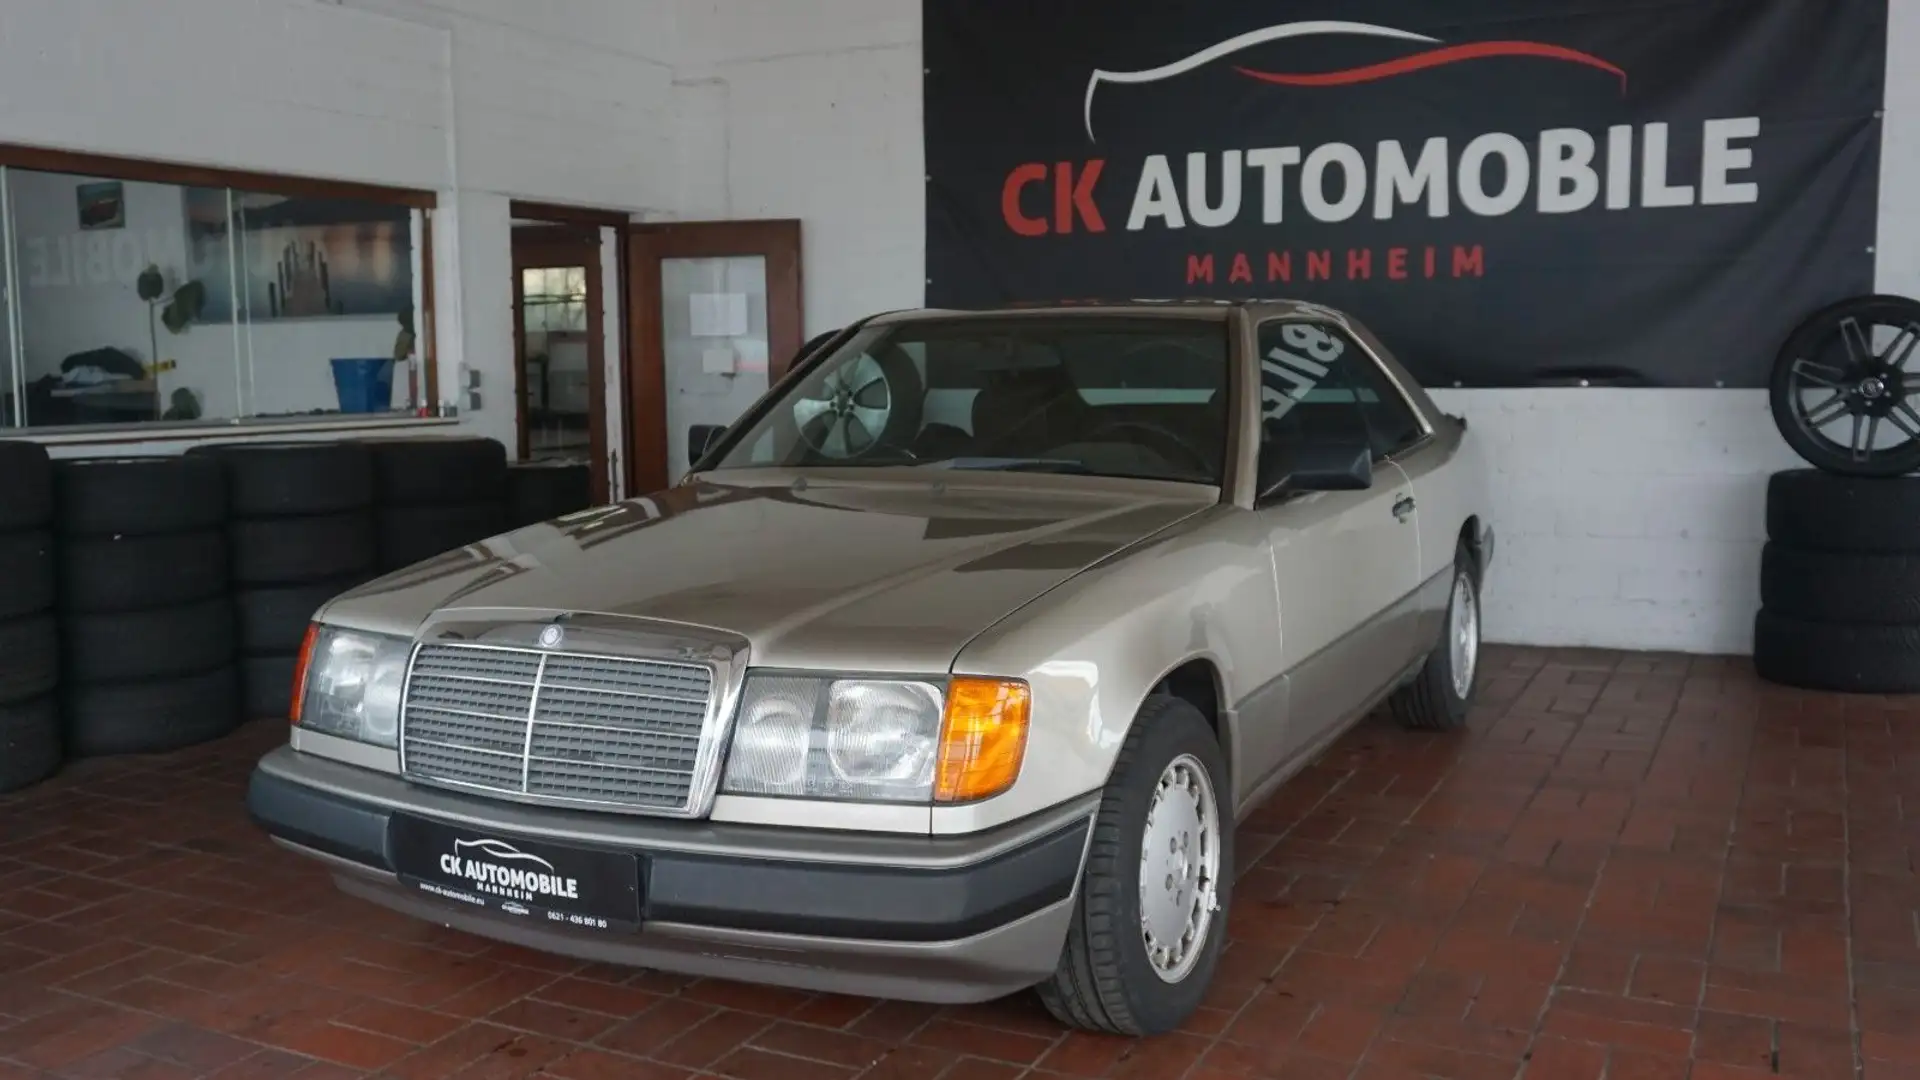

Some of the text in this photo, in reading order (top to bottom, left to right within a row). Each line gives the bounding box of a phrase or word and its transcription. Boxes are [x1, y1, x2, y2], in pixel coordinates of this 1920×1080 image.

[1002, 116, 1761, 236] CK AUTOMOBILE
[1186, 244, 1486, 285] MANNHEIM
[440, 853, 578, 898] CK AUTOMOBILE
[476, 882, 533, 901] MANNHEIM
